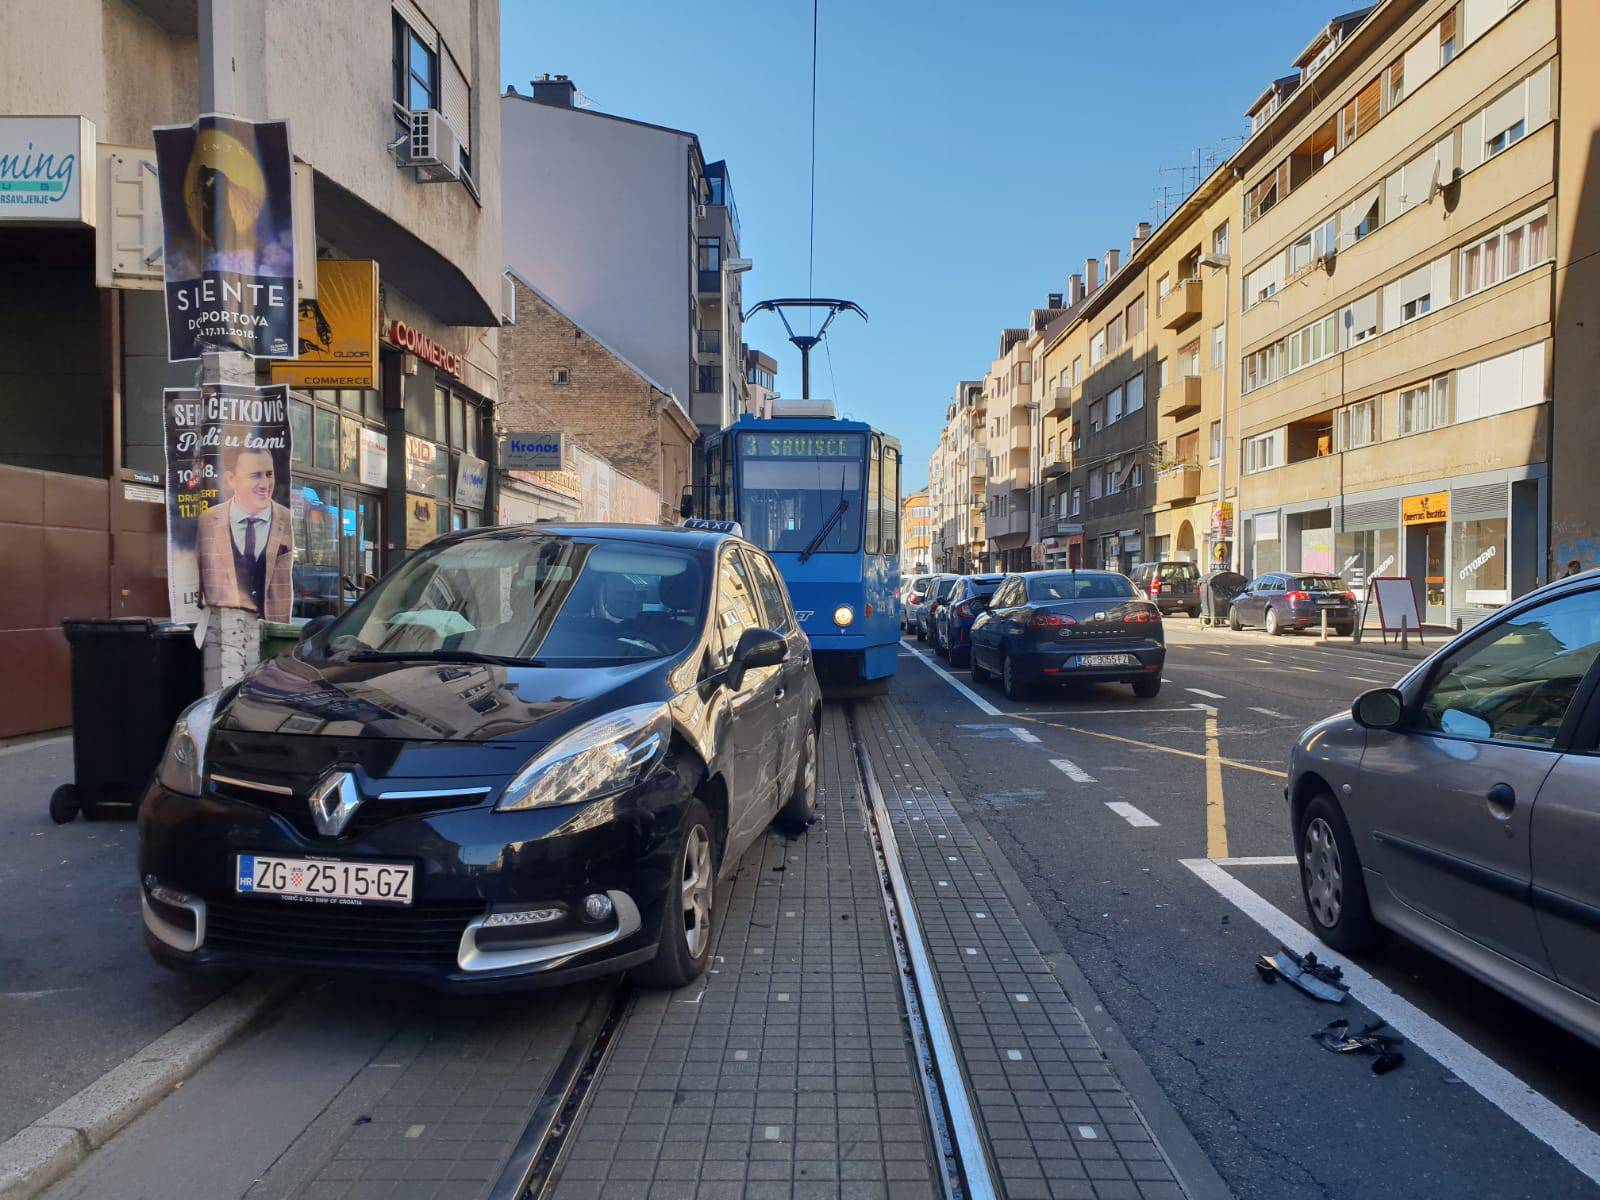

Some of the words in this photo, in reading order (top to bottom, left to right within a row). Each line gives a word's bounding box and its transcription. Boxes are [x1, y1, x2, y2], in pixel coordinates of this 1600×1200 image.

[177, 279, 285, 311] SIENTE
[396, 320, 462, 378] COMMERCE
[304, 377, 370, 385] COMMERCE
[208, 391, 285, 423] ĆETKOVIĆ
[224, 435, 240, 448] u
[243, 430, 286, 449] tami
[511, 440, 558, 453] Kronos
[747, 435, 757, 456] 3
[691, 520, 731, 530] TAXI
[1460, 545, 1496, 580] OTVORENO
[239, 877, 253, 887] HR
[256, 860, 287, 890] ZG
